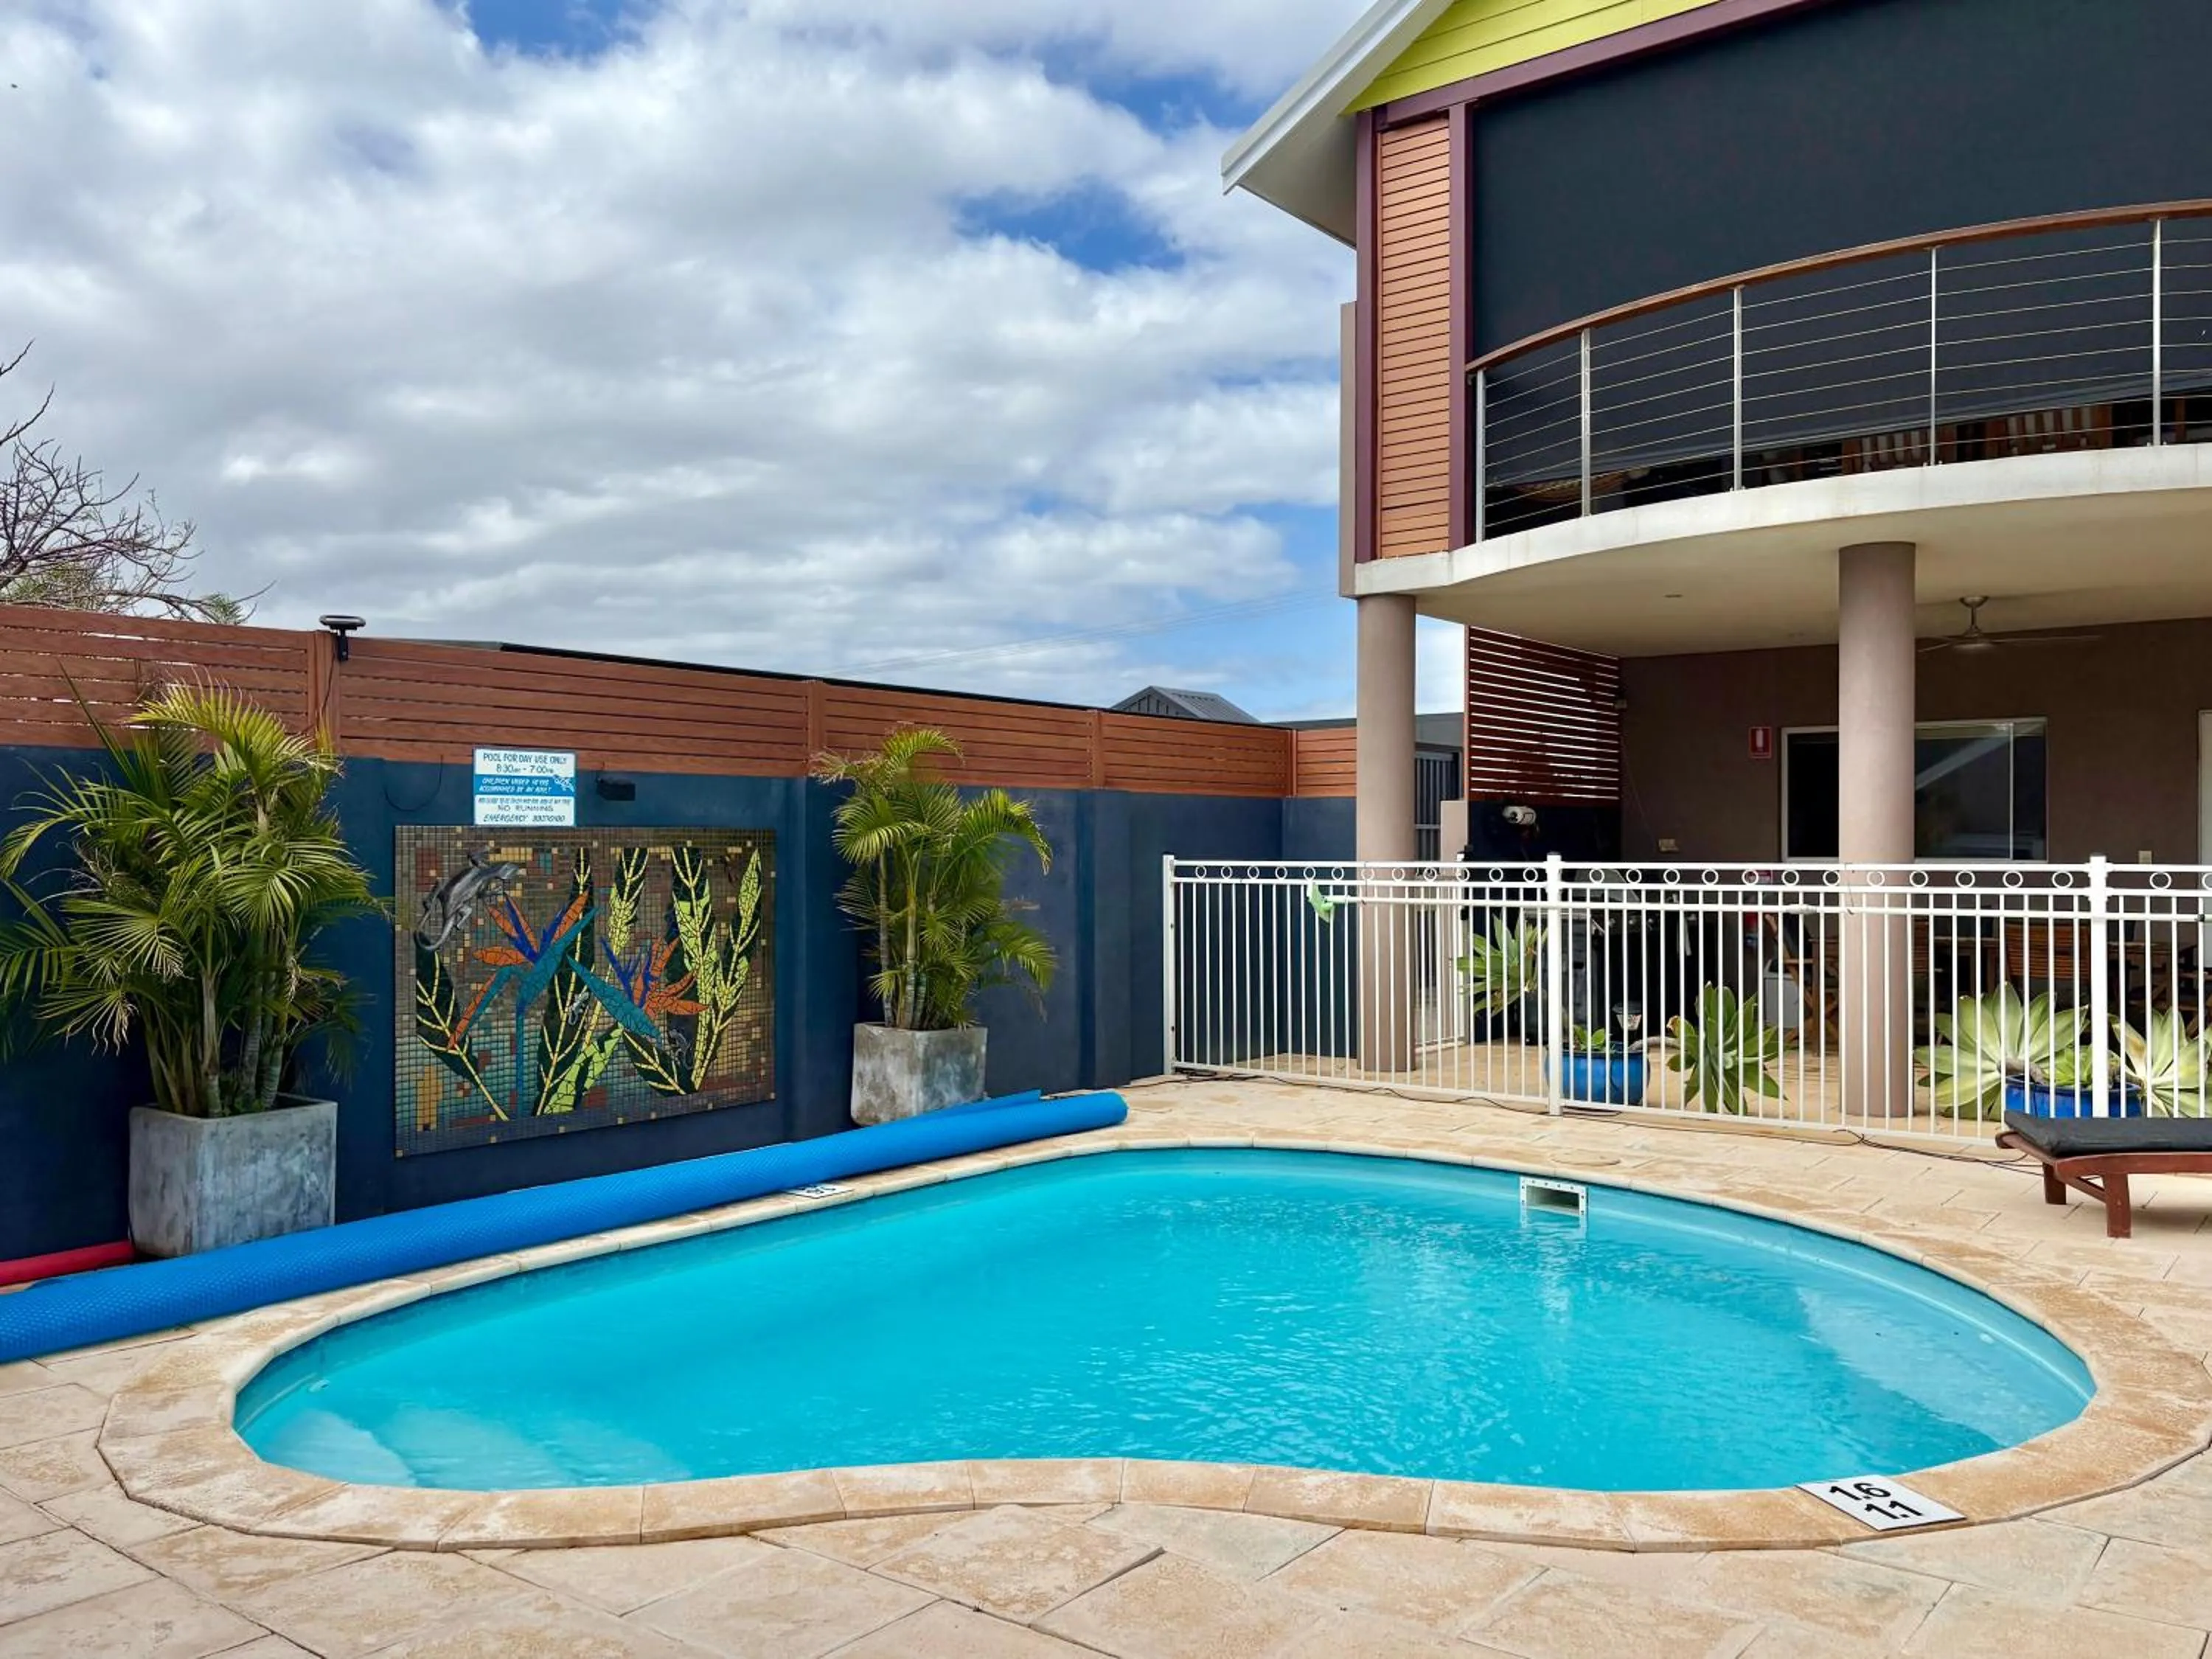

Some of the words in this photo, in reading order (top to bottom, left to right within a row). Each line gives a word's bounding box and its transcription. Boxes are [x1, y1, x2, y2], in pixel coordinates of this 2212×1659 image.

[484, 754, 501, 762] POOL
[504, 754, 518, 762] FOR
[519, 755, 532, 763] DAY
[535, 756, 548, 764] USE
[550, 757, 567, 765] ONLY
[483, 813, 528, 822] EMERGENCY
[1829, 1483, 1891, 1501] 1.6
[1865, 1500, 1923, 1520] 1.1
